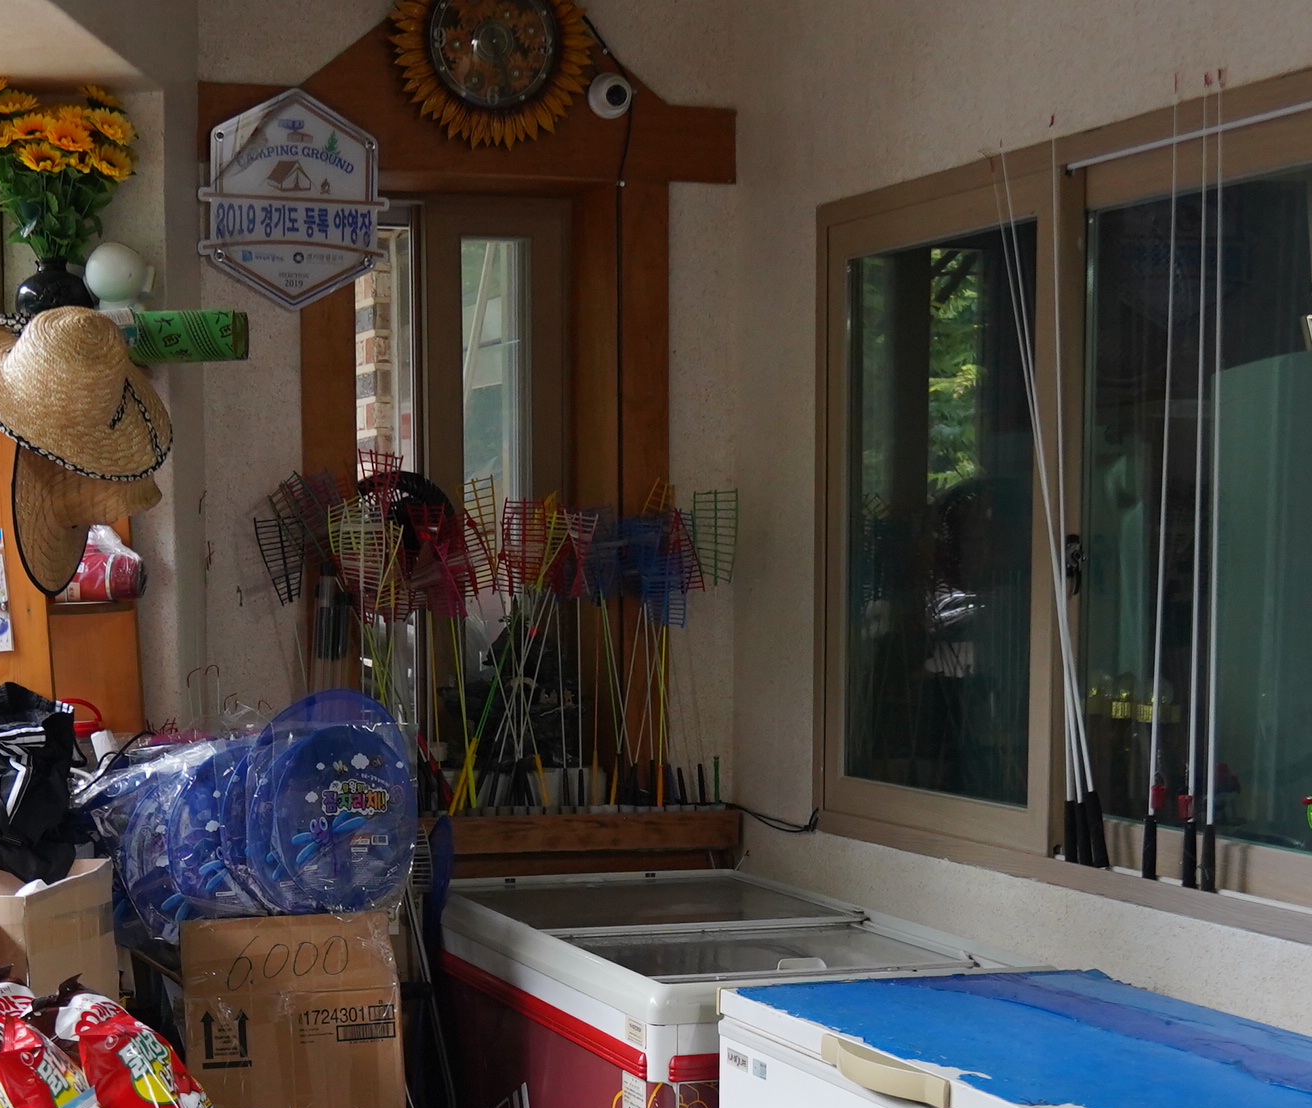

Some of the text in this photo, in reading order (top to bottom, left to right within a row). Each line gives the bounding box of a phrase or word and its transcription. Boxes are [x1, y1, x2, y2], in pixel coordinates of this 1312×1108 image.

[302, 146, 354, 175] GROUND
[216, 202, 373, 247] 2019 경기도 등록 야영장
[284, 280, 304, 288] 2019
[303, 1006, 366, 1026] 1724301
